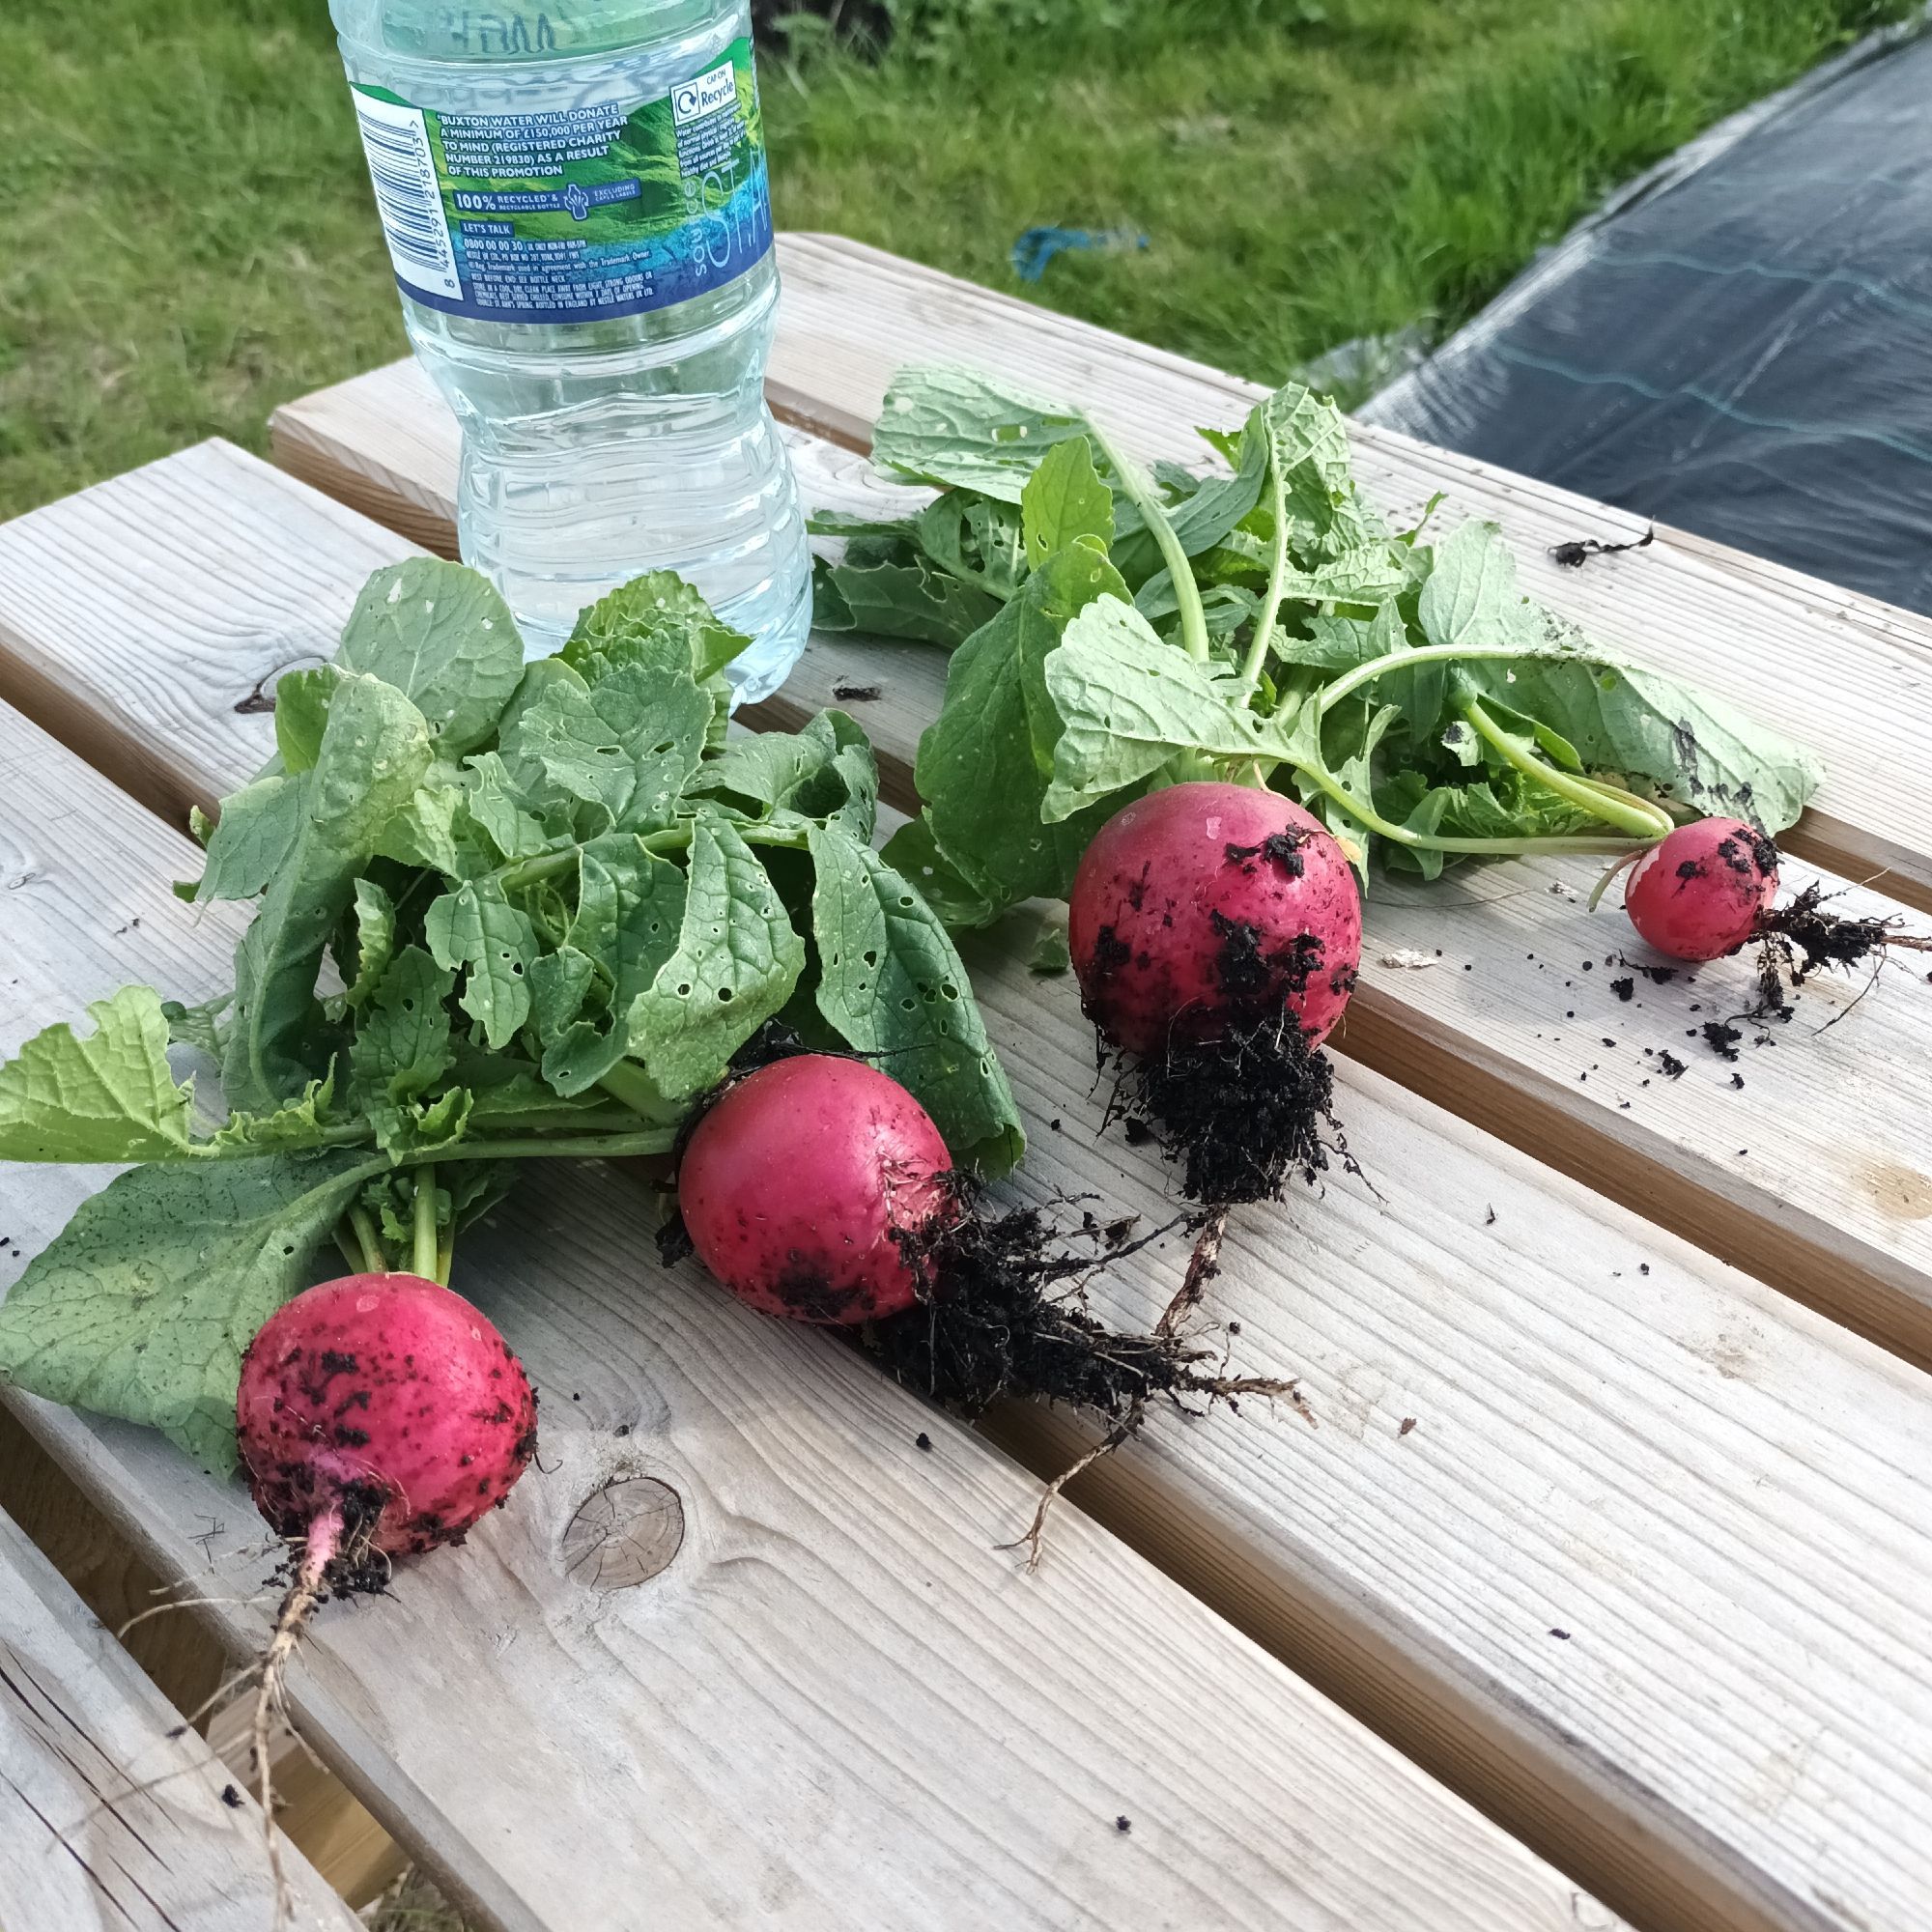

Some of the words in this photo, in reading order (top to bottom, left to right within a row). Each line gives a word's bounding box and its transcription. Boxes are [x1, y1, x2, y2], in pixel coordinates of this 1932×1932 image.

[707, 74, 716, 85] CAP
[717, 69, 725, 79] ON
[701, 78, 733, 107] Recycle
[491, 115, 533, 126] WATER
[536, 112, 566, 124] WILL
[569, 104, 618, 120] DONATE
[440, 128, 448, 137] A
[450, 128, 503, 139] MINIMUM
[506, 128, 521, 139] OF
[525, 124, 570, 139] £150,000
[573, 120, 596, 134] PER
[597, 115, 627, 130] YEAR
[442, 141, 457, 151] TO
[459, 141, 489, 152] MIND
[492, 139, 566, 154] (REGISTERED
[568, 130, 621, 146] CHARITY
[446, 154, 492, 164] NUMBER
[494, 153, 535, 166] 219830)
[538, 154, 552, 163] AS
[554, 153, 564, 162] A
[567, 146, 609, 160] RESULT
[412, 137, 436, 199] 218703
[448, 166, 461, 175] OF
[463, 167, 488, 177] THIS
[492, 165, 563, 178] PROMOTION
[595, 184, 635, 196] EXCLUDING
[457, 194, 496, 210] 100%
[464, 223, 486, 233] LET'S
[488, 224, 511, 234] TALK
[684, 181, 707, 277] source
[428, 208, 449, 269] 445291
[465, 239, 484, 250] 0800
[486, 239, 497, 250] 00
[498, 240, 510, 251] 00
[511, 241, 523, 251] 30
[601, 254, 630, 266] Trademark
[443, 279, 455, 288] 8
